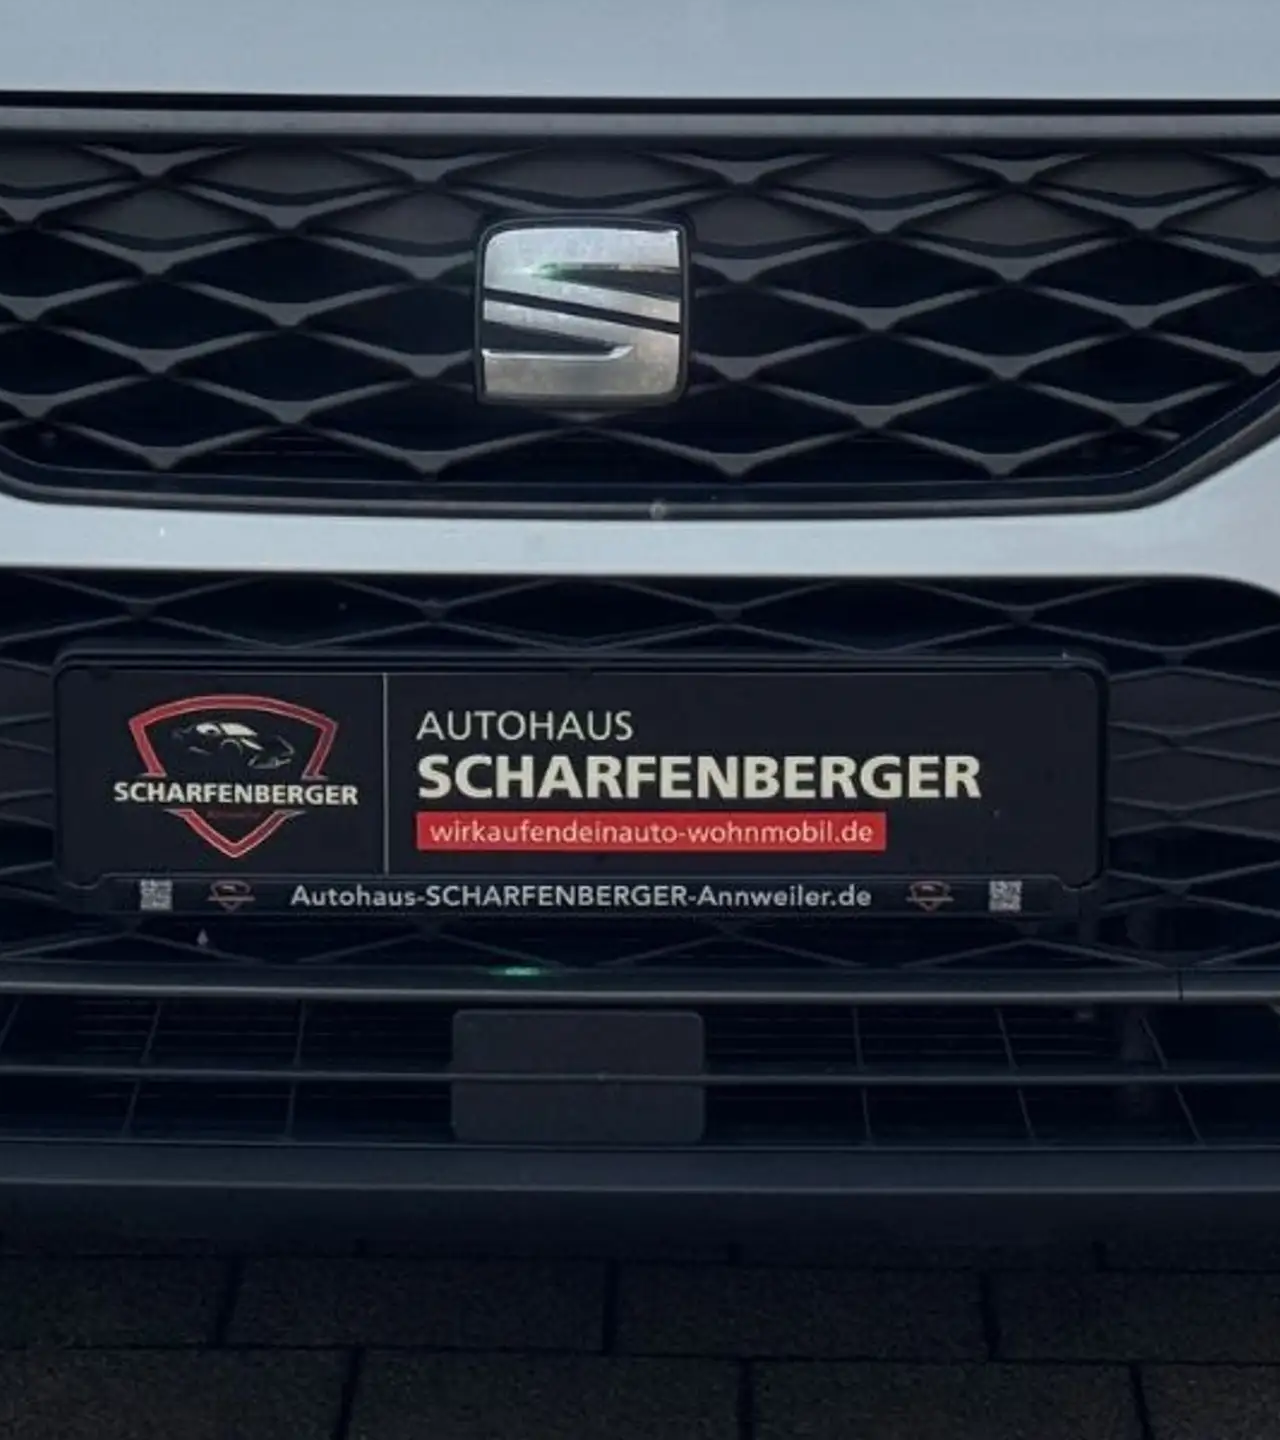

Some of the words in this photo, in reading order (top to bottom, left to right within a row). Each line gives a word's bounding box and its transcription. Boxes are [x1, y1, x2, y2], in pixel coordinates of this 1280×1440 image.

[416, 711, 634, 741] AUTOHAUS
[419, 755, 981, 799] SCHARFENBERGER
[114, 782, 359, 806] SCHARFENBERGER
[430, 821, 873, 844] wirkaufendeinauto-wohnmobil.de
[291, 885, 872, 907] Autohaus-SCHARFENBERGER-Annweiler.de
